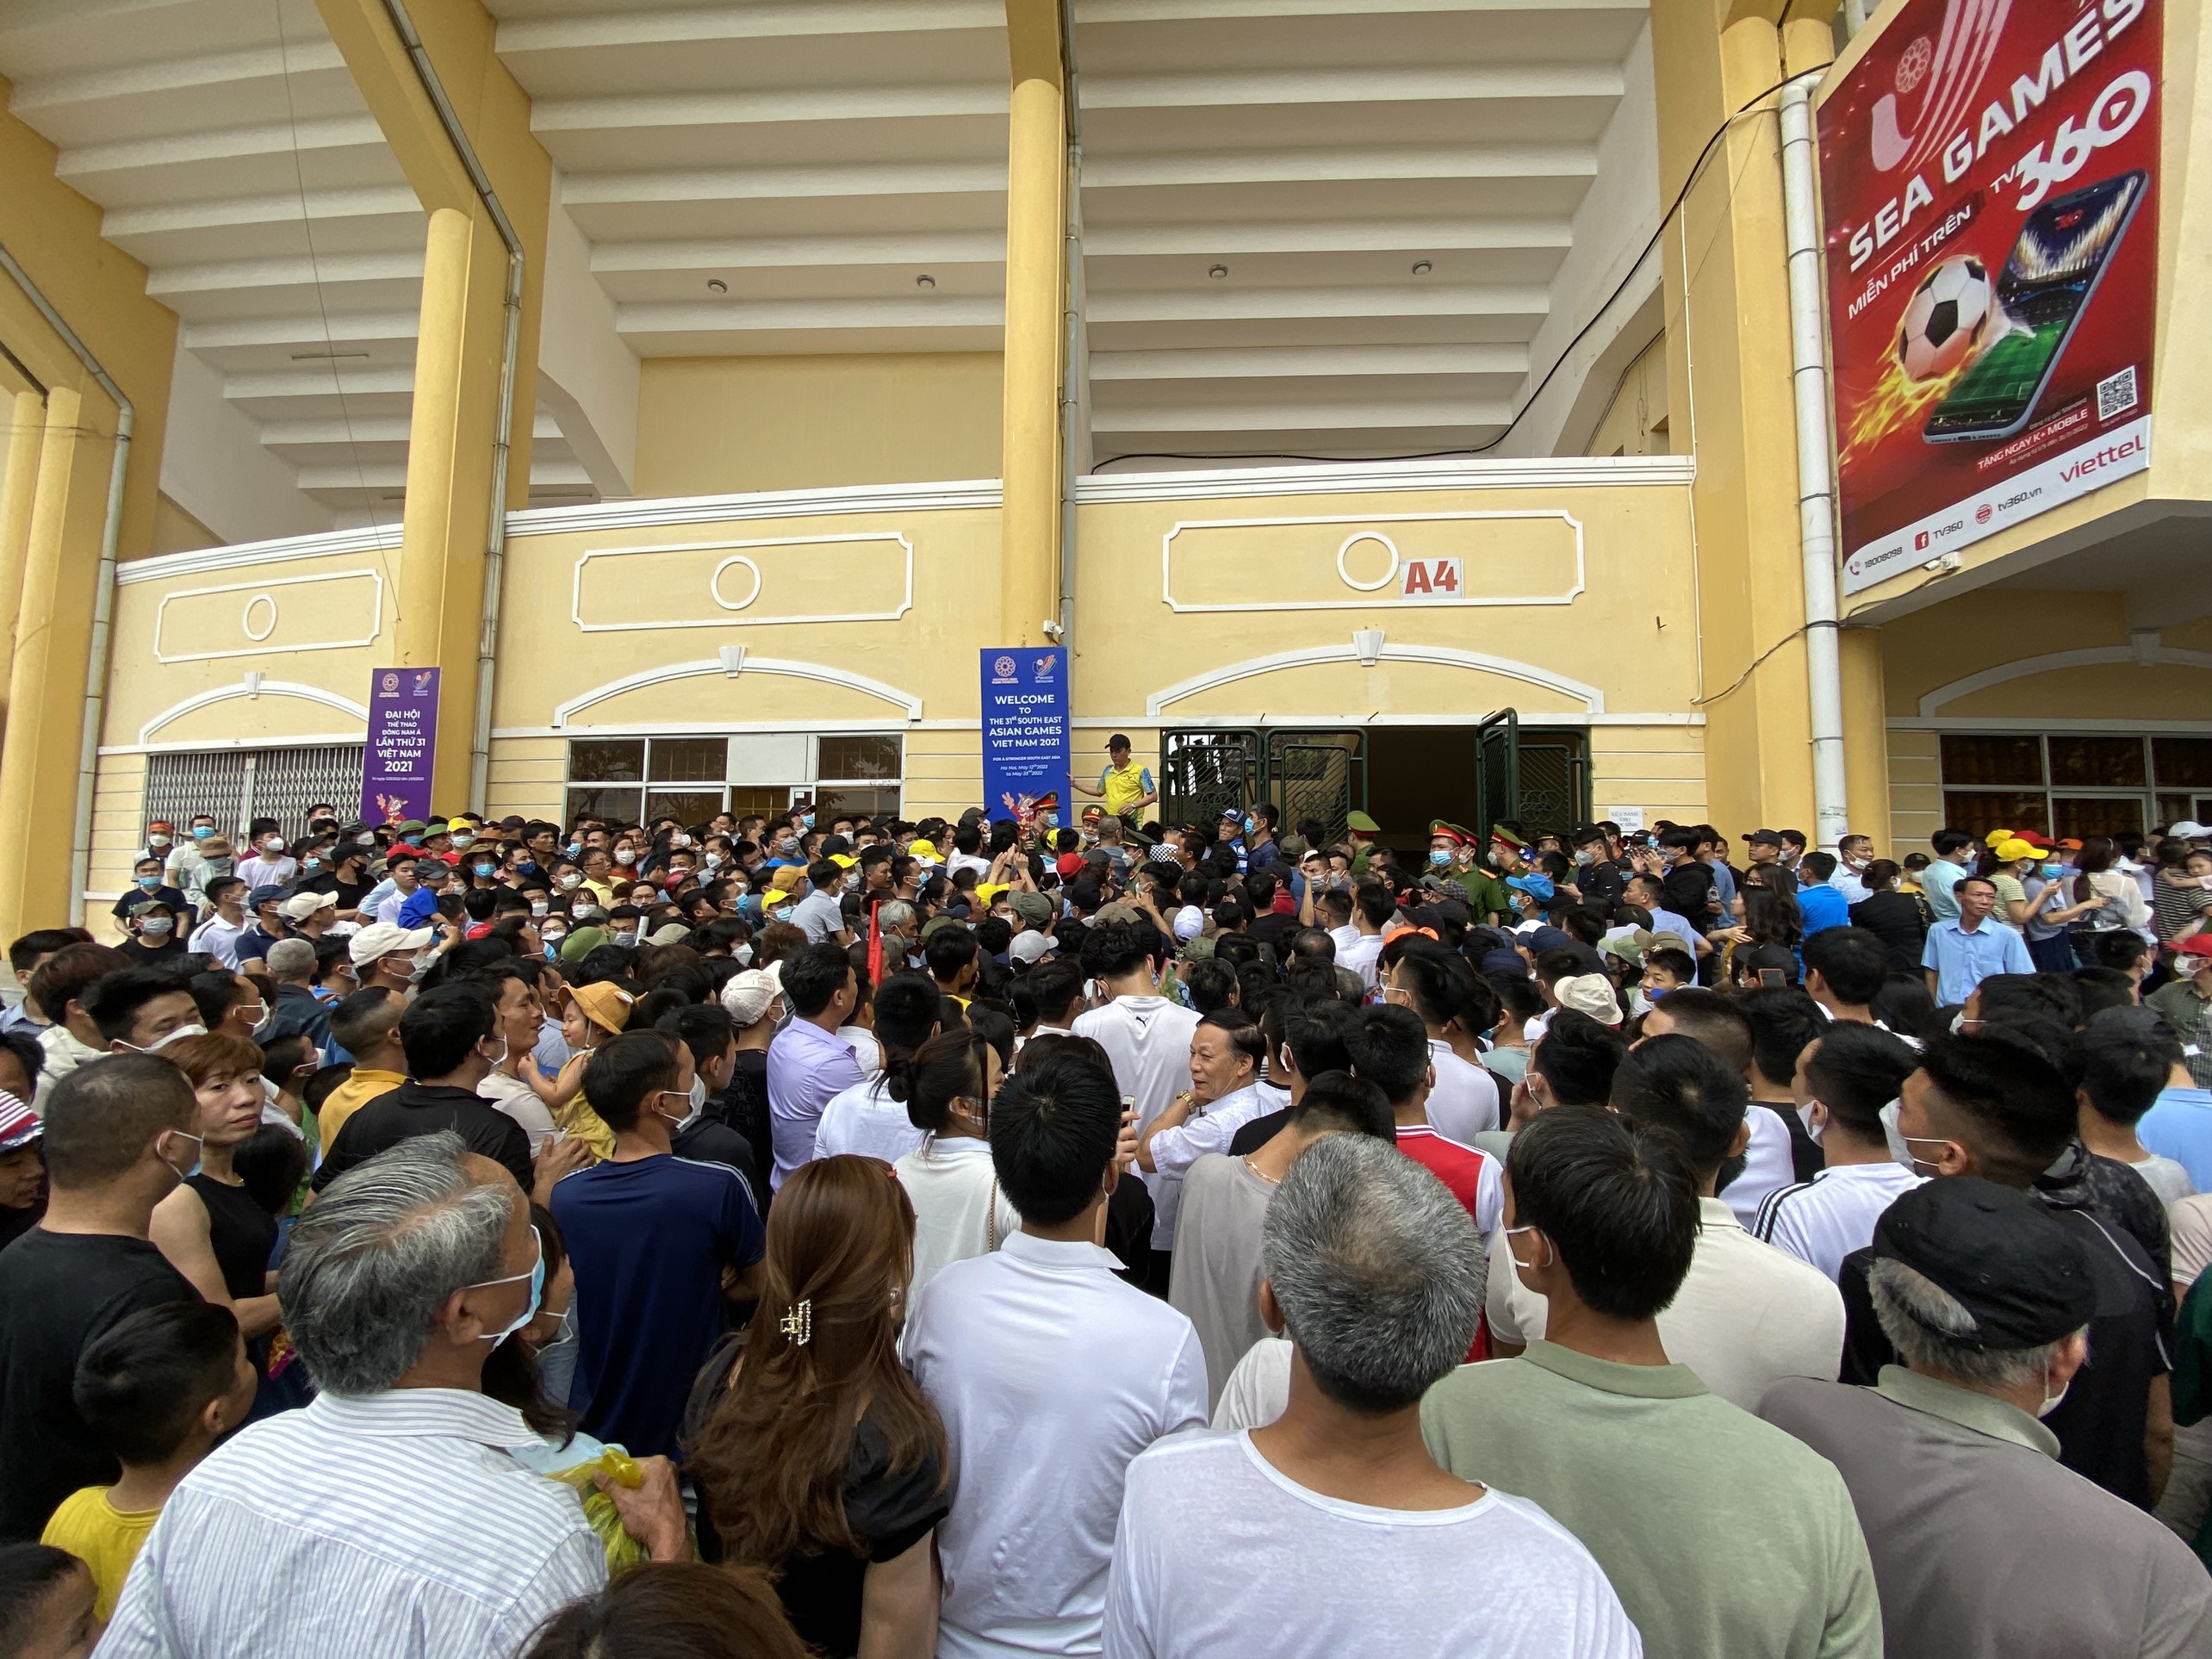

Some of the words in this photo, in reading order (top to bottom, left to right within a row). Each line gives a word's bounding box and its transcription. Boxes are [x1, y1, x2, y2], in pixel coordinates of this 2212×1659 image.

[1849, 173, 1934, 273] SEA
[1943, 0, 2146, 184] GAMES
[1848, 276, 1888, 320] MIỄN
[1891, 243, 1918, 283] PHÍ
[1921, 204, 1972, 254] TRÊN
[2004, 435, 2034, 457] NGAY
[2033, 432, 2046, 443] K+
[2047, 408, 2088, 436] MOBILE
[1998, 487, 2042, 513] tv360.vn
[1932, 520, 1964, 540] TV360
[1864, 546, 1903, 569] 18008098
[1405, 560, 1458, 594] A4
[995, 694, 1055, 705] WELCOME
[385, 711, 401, 721] ĐẠI
[403, 708, 420, 721] HỘI
[989, 727, 1022, 736] ASIAN
[1024, 726, 1062, 736] GAMES
[416, 738, 426, 747] 31
[992, 739, 1014, 748] VIET
[1015, 738, 1038, 747] NAM
[377, 748, 398, 760] VIỆT
[399, 749, 422, 758] NAM
[384, 761, 413, 773] 2021
